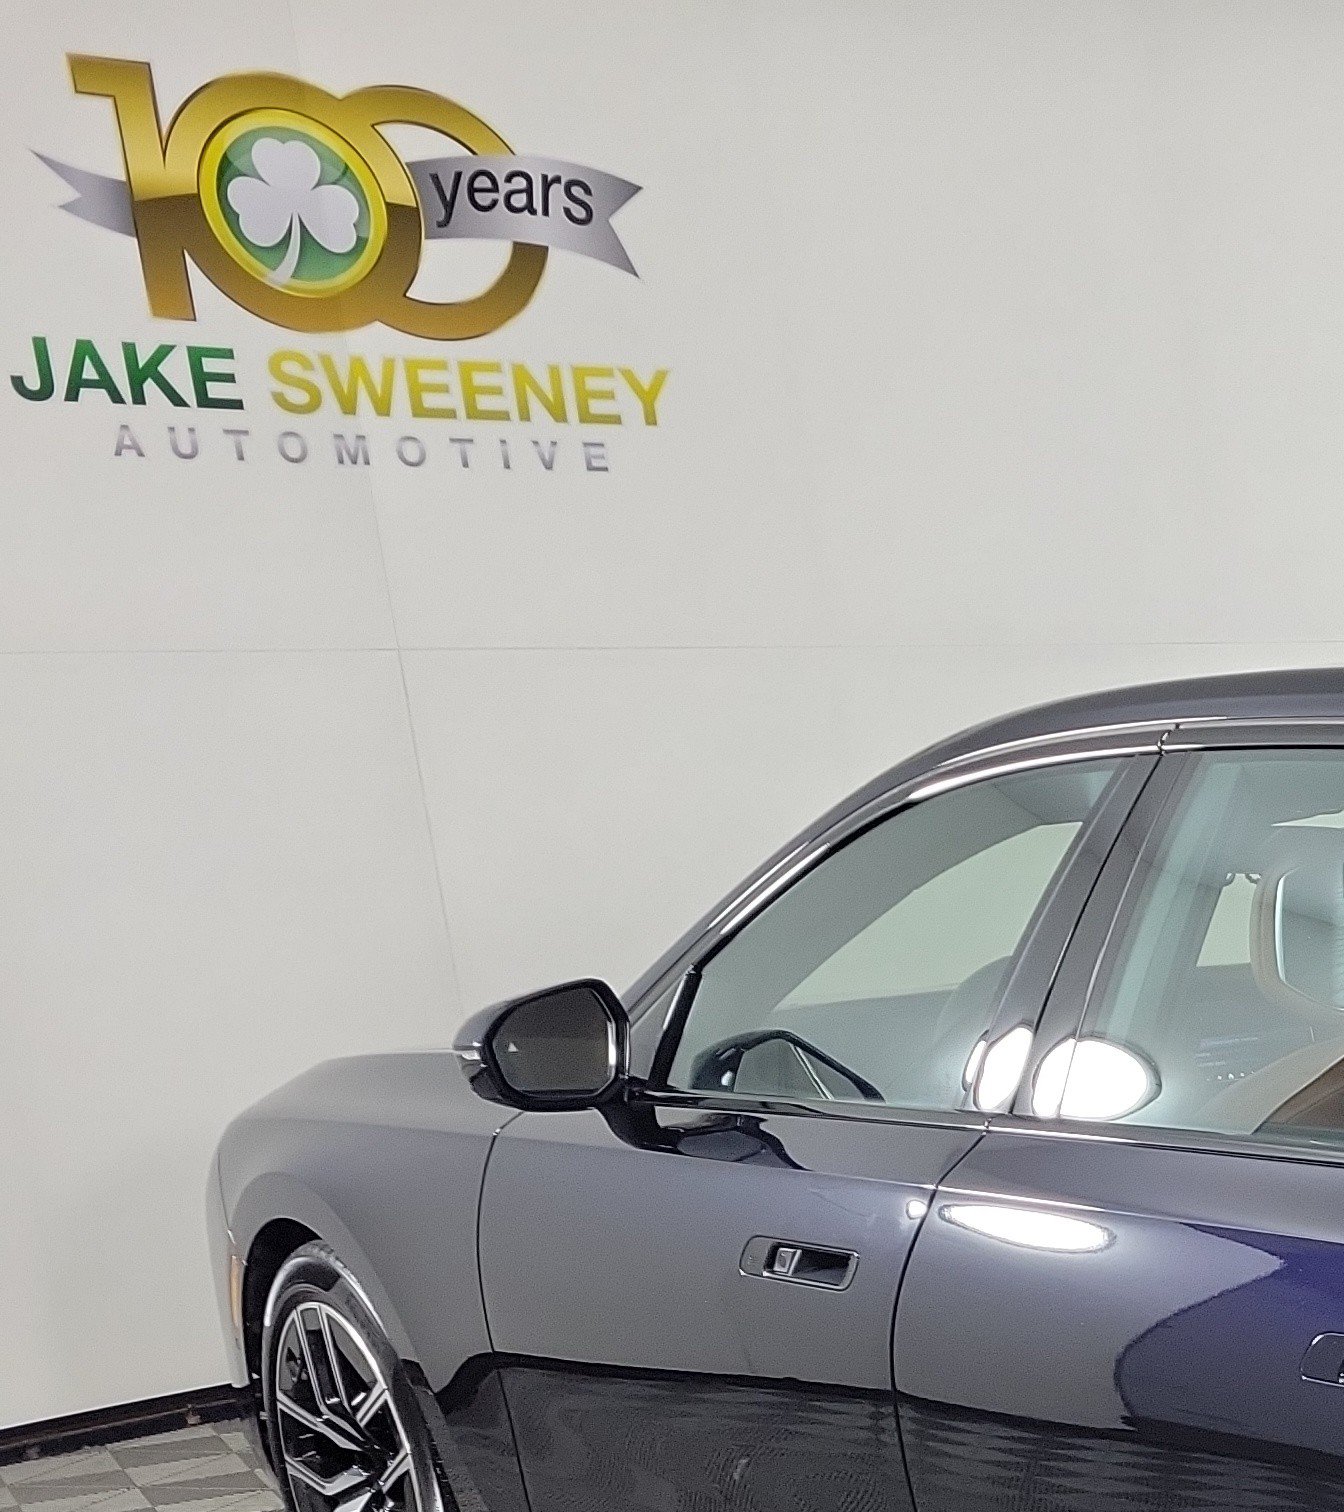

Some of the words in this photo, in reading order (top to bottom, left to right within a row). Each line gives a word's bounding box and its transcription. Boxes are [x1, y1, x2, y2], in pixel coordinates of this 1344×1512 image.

[429, 164, 595, 227] years
[10, 335, 245, 412] JAKE
[267, 349, 670, 428] SWEENEY
[114, 424, 610, 473] AUTOMOTIVE
